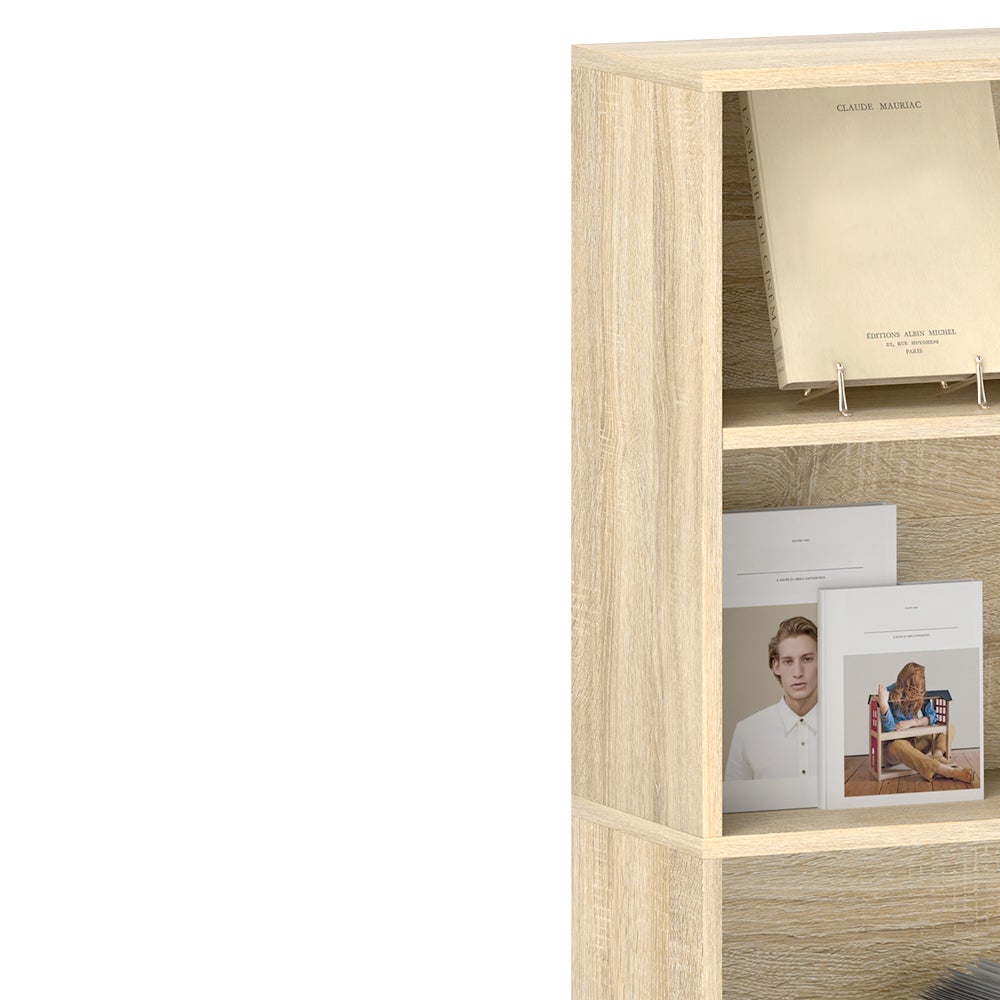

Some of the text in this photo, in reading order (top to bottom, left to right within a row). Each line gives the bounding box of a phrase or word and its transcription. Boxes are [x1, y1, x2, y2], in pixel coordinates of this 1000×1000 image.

[836, 101, 922, 112] CLAUDE MAURIAC
[757, 216, 766, 245] DU
[762, 254, 779, 337] CINEMA
[866, 328, 957, 340] ÉDITIONS ALBIN MICHEL
